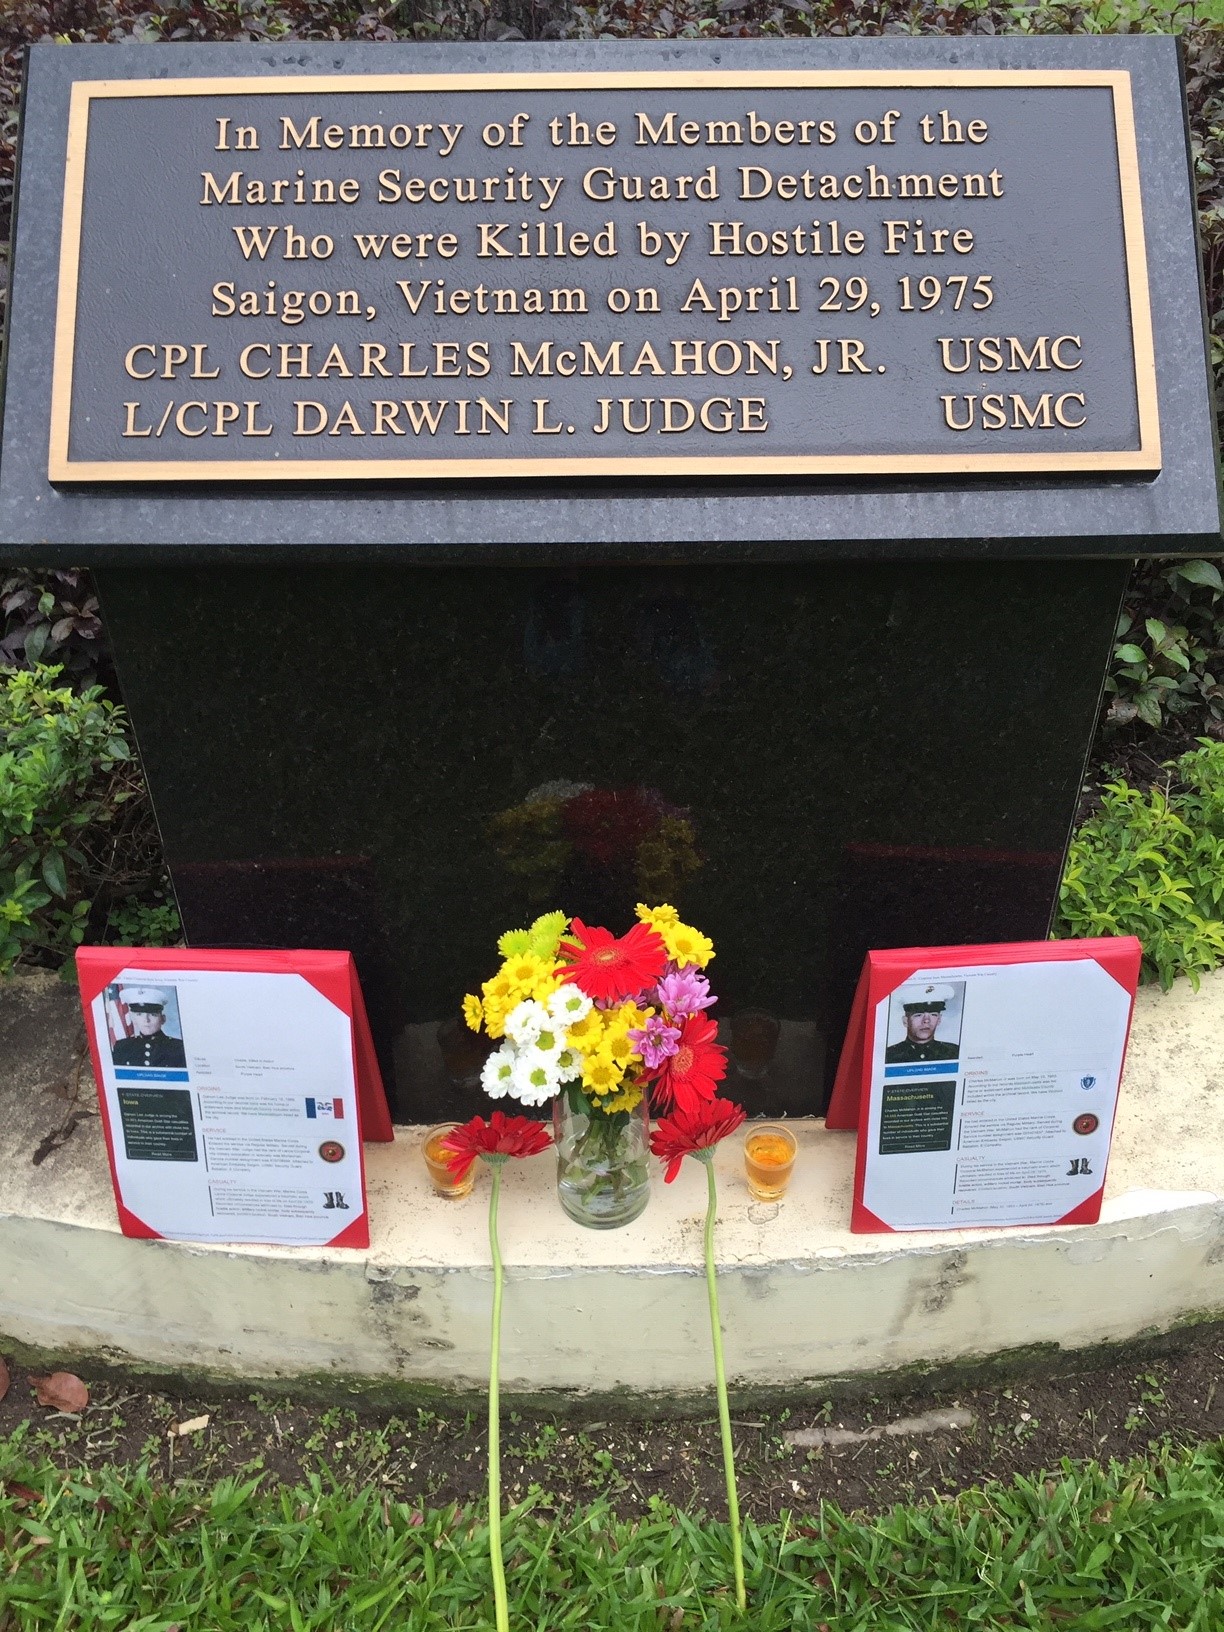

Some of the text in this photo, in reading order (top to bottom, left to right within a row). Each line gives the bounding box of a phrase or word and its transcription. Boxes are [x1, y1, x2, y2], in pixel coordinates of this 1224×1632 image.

[216, 109, 989, 156] In Memory of the Members of the
[200, 165, 1004, 210] Marine Security Guard Detachment
[233, 219, 975, 266] Who were Killed by Hostile Fire
[211, 274, 996, 325] Saigon, Vietnam on April 29, 1975
[124, 334, 1083, 380] CPL CHARLES McMAHON, JR. USMC
[122, 392, 1087, 437] L/CPL DARWIN L. JUDGE USMC
[886, 1093, 934, 1102] Massachusetts
